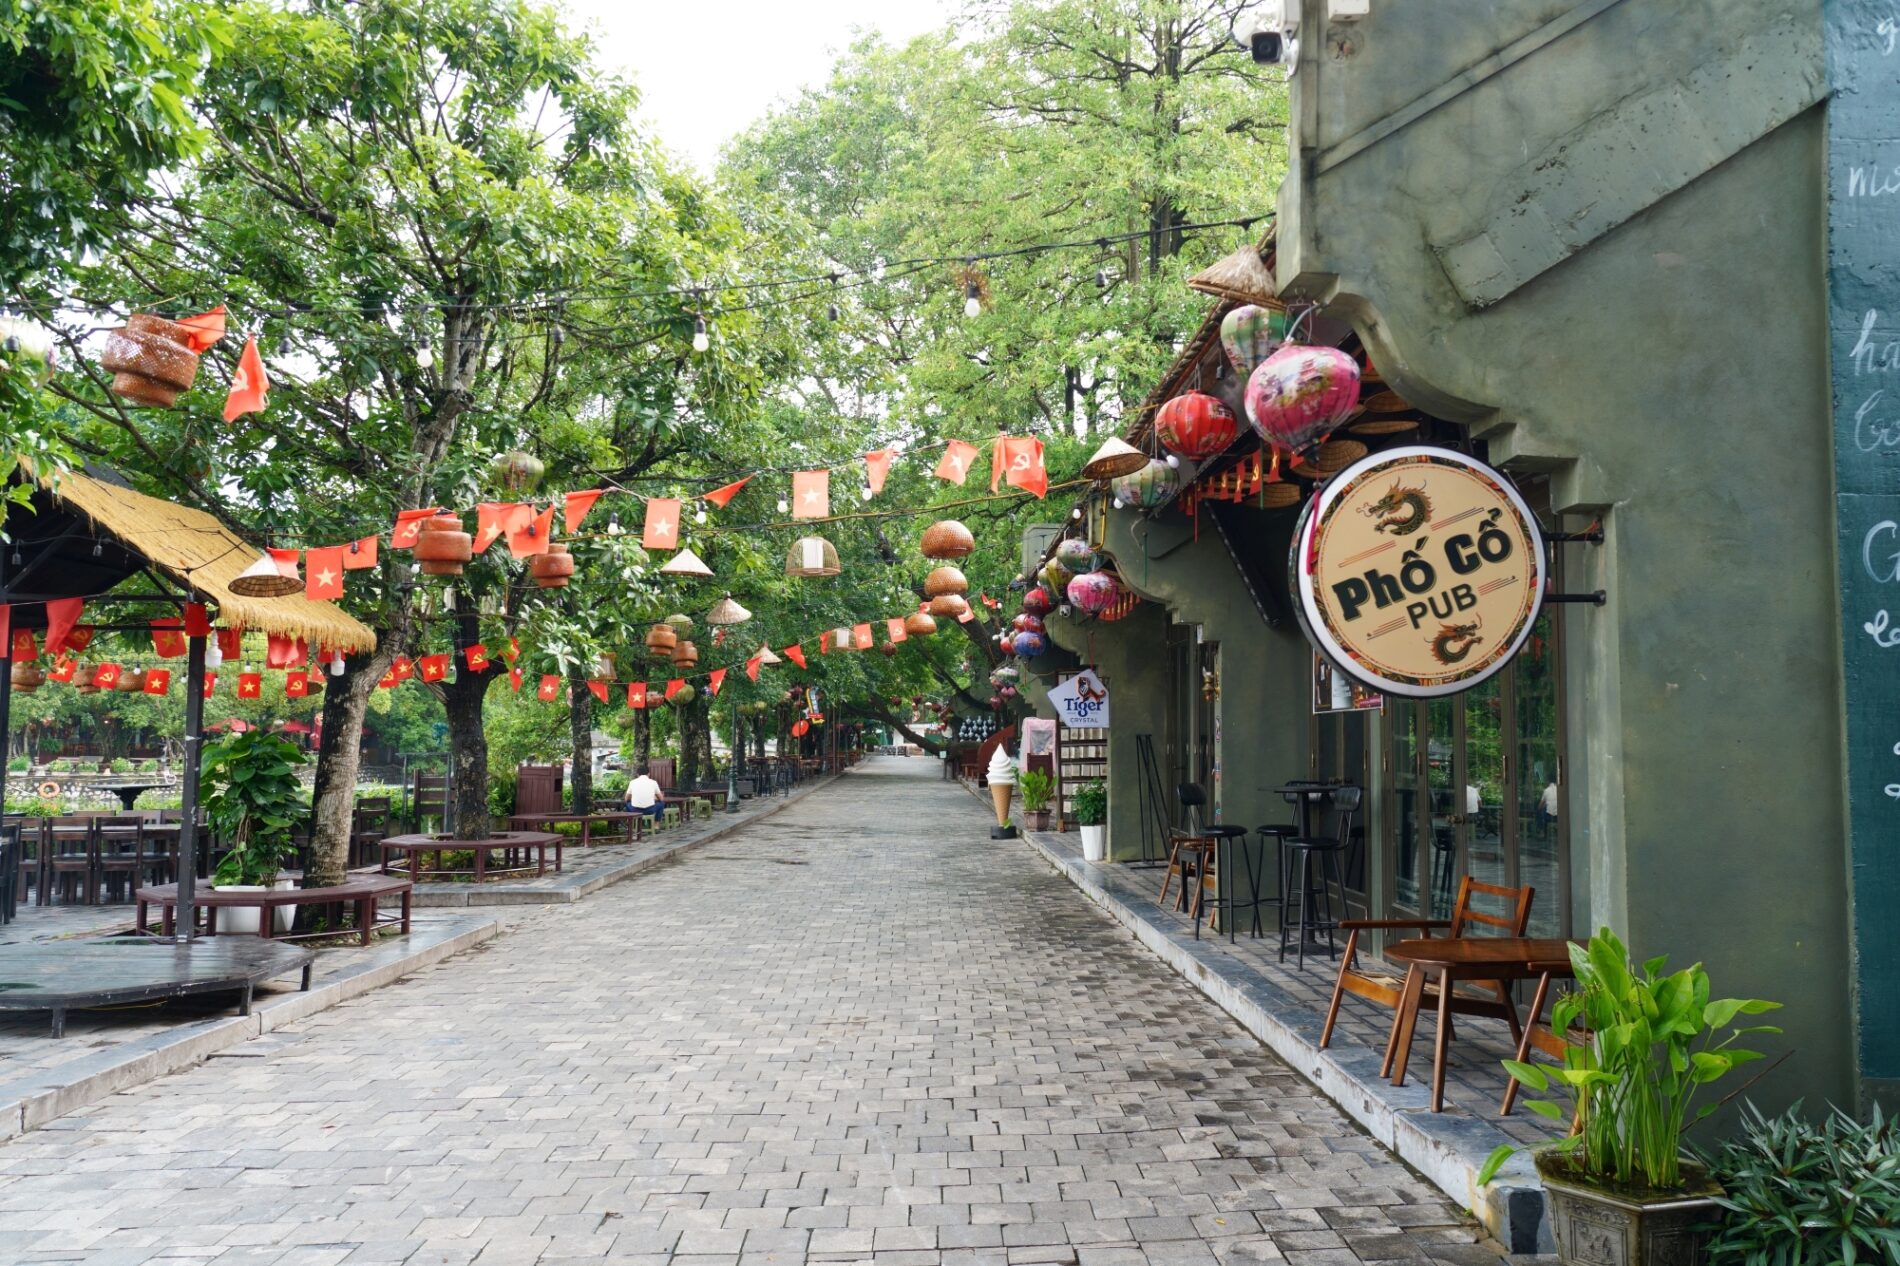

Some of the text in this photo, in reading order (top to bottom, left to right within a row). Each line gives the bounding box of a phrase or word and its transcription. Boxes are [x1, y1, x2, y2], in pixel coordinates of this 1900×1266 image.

[1331, 507, 1513, 622] Phố Cổ
[1406, 583, 1478, 630] PUB
